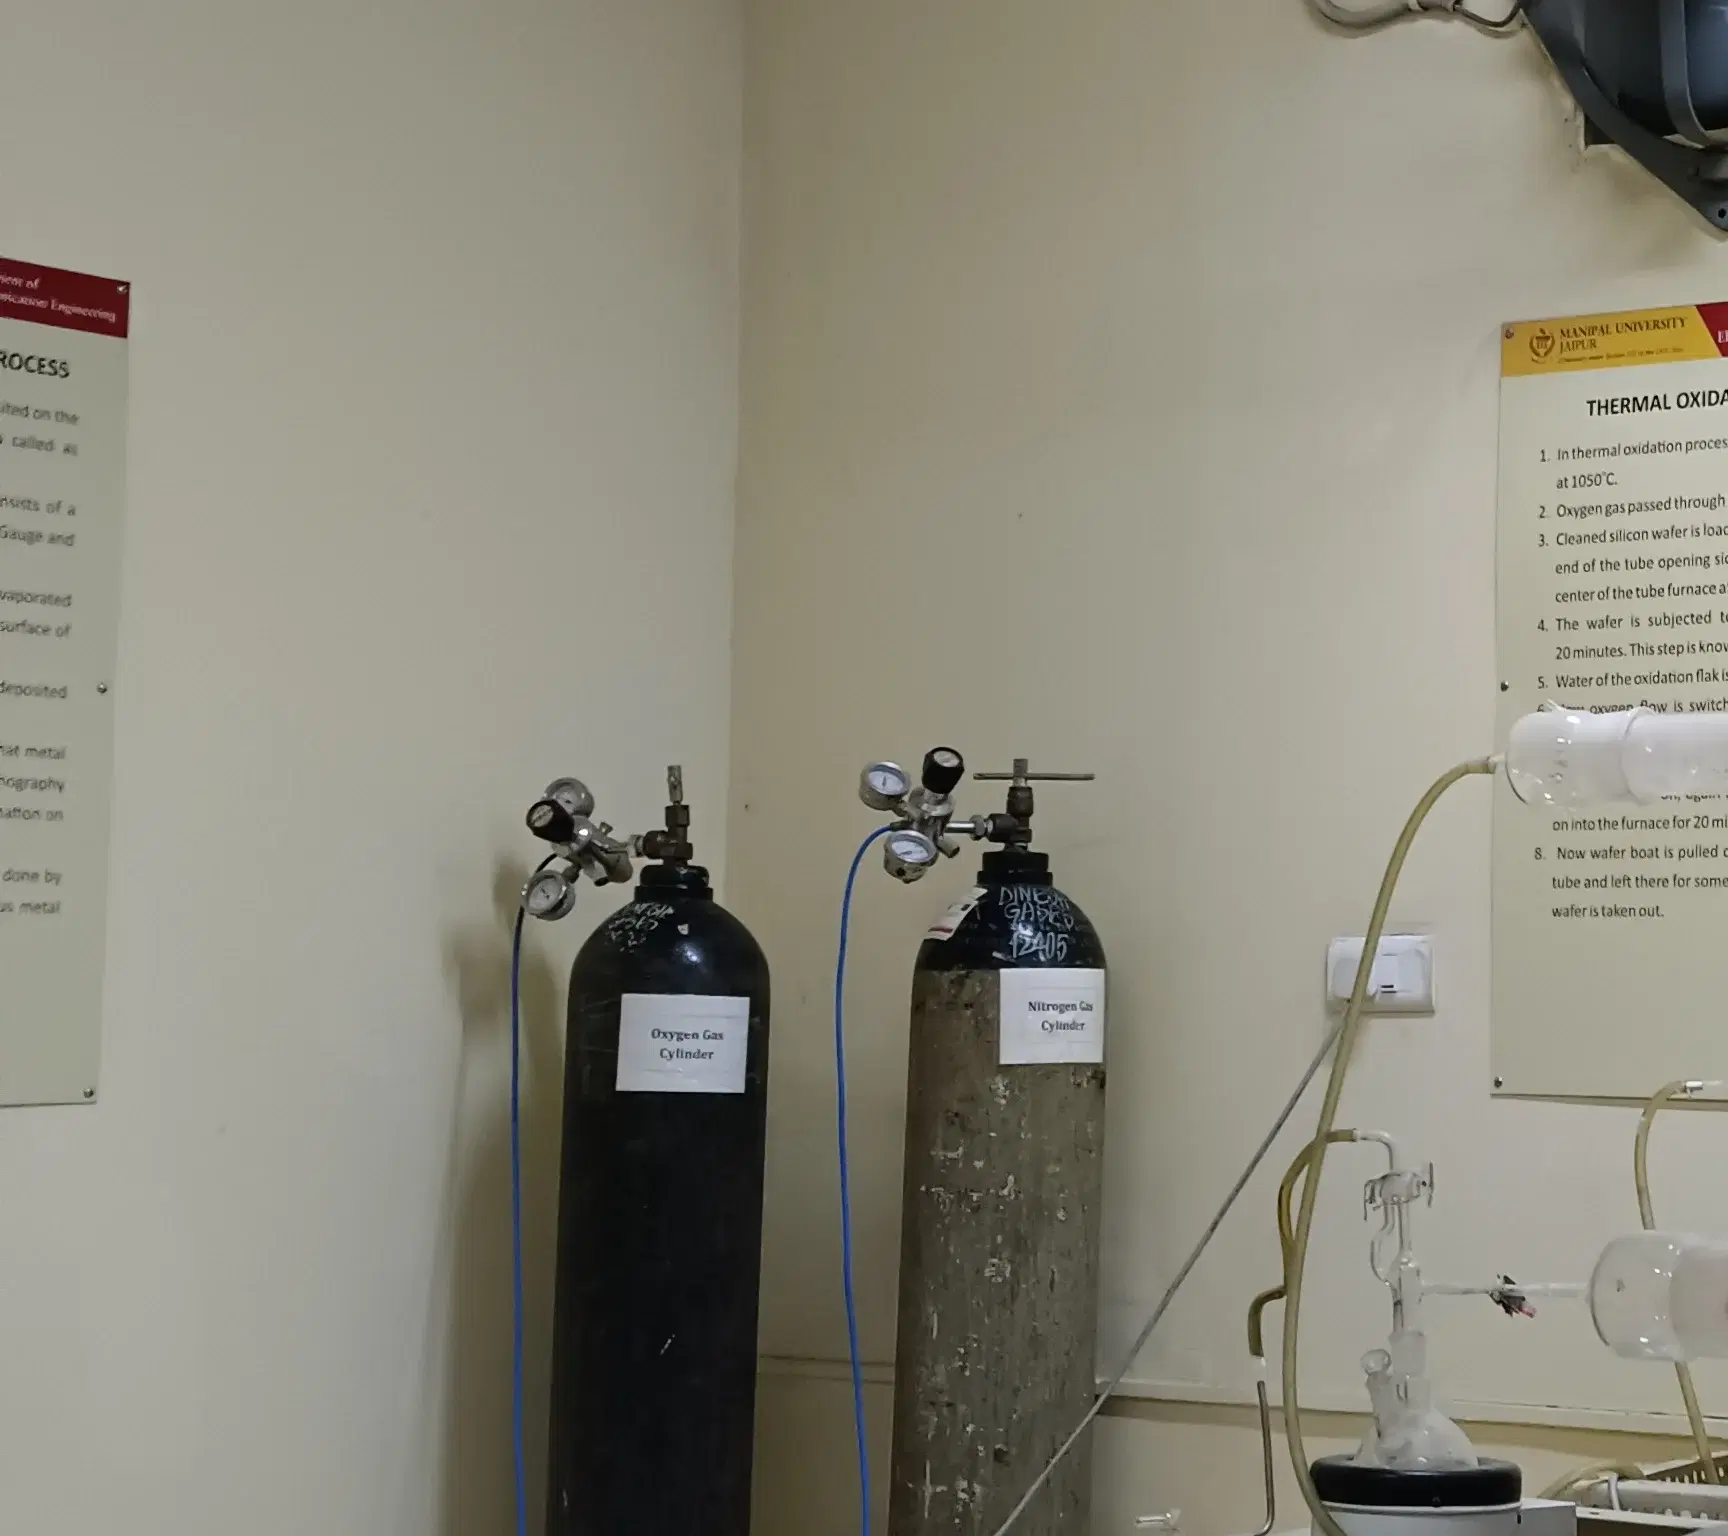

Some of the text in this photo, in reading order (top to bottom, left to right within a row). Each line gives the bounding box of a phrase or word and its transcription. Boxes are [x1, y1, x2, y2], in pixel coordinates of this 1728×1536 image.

[1615, 316, 1688, 334] UNIVERSITY
[1559, 338, 1597, 354] JAIPUR
[1586, 393, 1672, 417] THERMAL
[1557, 447, 1569, 461] In
[1572, 443, 1621, 460] thermal
[1623, 439, 1682, 456] oxidation
[1556, 477, 1568, 490] at
[46, 500, 62, 514] of
[1556, 503, 1603, 520] Oxygen
[1604, 502, 1626, 518] gas
[1627, 496, 1672, 516] passed
[1674, 492, 1725, 511] through
[47, 532, 75, 547] and
[1538, 533, 1549, 548] 3.
[1556, 529, 1607, 546] Cleaned
[1609, 527, 1649, 543] silicon
[1651, 524, 1688, 540] wafer
[1690, 523, 1701, 538] is
[1555, 559, 1579, 575] end
[1582, 557, 1596, 573] of
[1599, 557, 1621, 572] the
[1624, 555, 1654, 571] tube
[1657, 552, 1711, 571] opening
[1555, 589, 1595, 603] center
[1597, 585, 1611, 601] of
[1612, 584, 1634, 600] the
[1635, 583, 1665, 599] tube
[1667, 582, 1717, 597] furnace
[1555, 617, 1579, 631] The
[1586, 614, 1624, 630] wafer
[1630, 613, 1641, 628] is
[1647, 608, 1712, 629] subjected
[55, 623, 71, 638] of
[1555, 646, 1571, 661] 20
[1573, 644, 1627, 659] minutes.
[1629, 642, 1655, 657] This
[1657, 641, 1685, 658] step
[1686, 640, 1696, 654] is
[1555, 673, 1594, 689] Water
[1595, 672, 1609, 687] of
[1611, 671, 1632, 686] the
[1633, 669, 1694, 685] oxidation
[1696, 667, 1720, 683] flak
[1673, 699, 1684, 713] is
[24, 745, 67, 760] metal
[1552, 819, 1569, 832] on
[1571, 817, 1596, 831] into
[1598, 816, 1619, 831] the
[1621, 815, 1670, 830] furnace
[1672, 814, 1691, 829] for
[1693, 815, 1709, 829] 20
[1557, 846, 1586, 861] Now
[1589, 844, 1626, 860] wafer
[1630, 844, 1660, 859] boat
[1664, 844, 1674, 859] is
[1678, 843, 1719, 861] pulled
[1552, 875, 1581, 889] tube
[1583, 874, 1608, 889] and
[1610, 873, 1632, 889] left
[1635, 873, 1669, 889] there
[1672, 873, 1691, 888] for
[1552, 903, 1664, 918] wafer is taken out.
[1028, 1000, 1078, 1015] Nitrogen
[1041, 1019, 1086, 1033] Cylinder
[651, 1028, 724, 1042] Oxygen Gas
[659, 1047, 714, 1061] Cylinder
